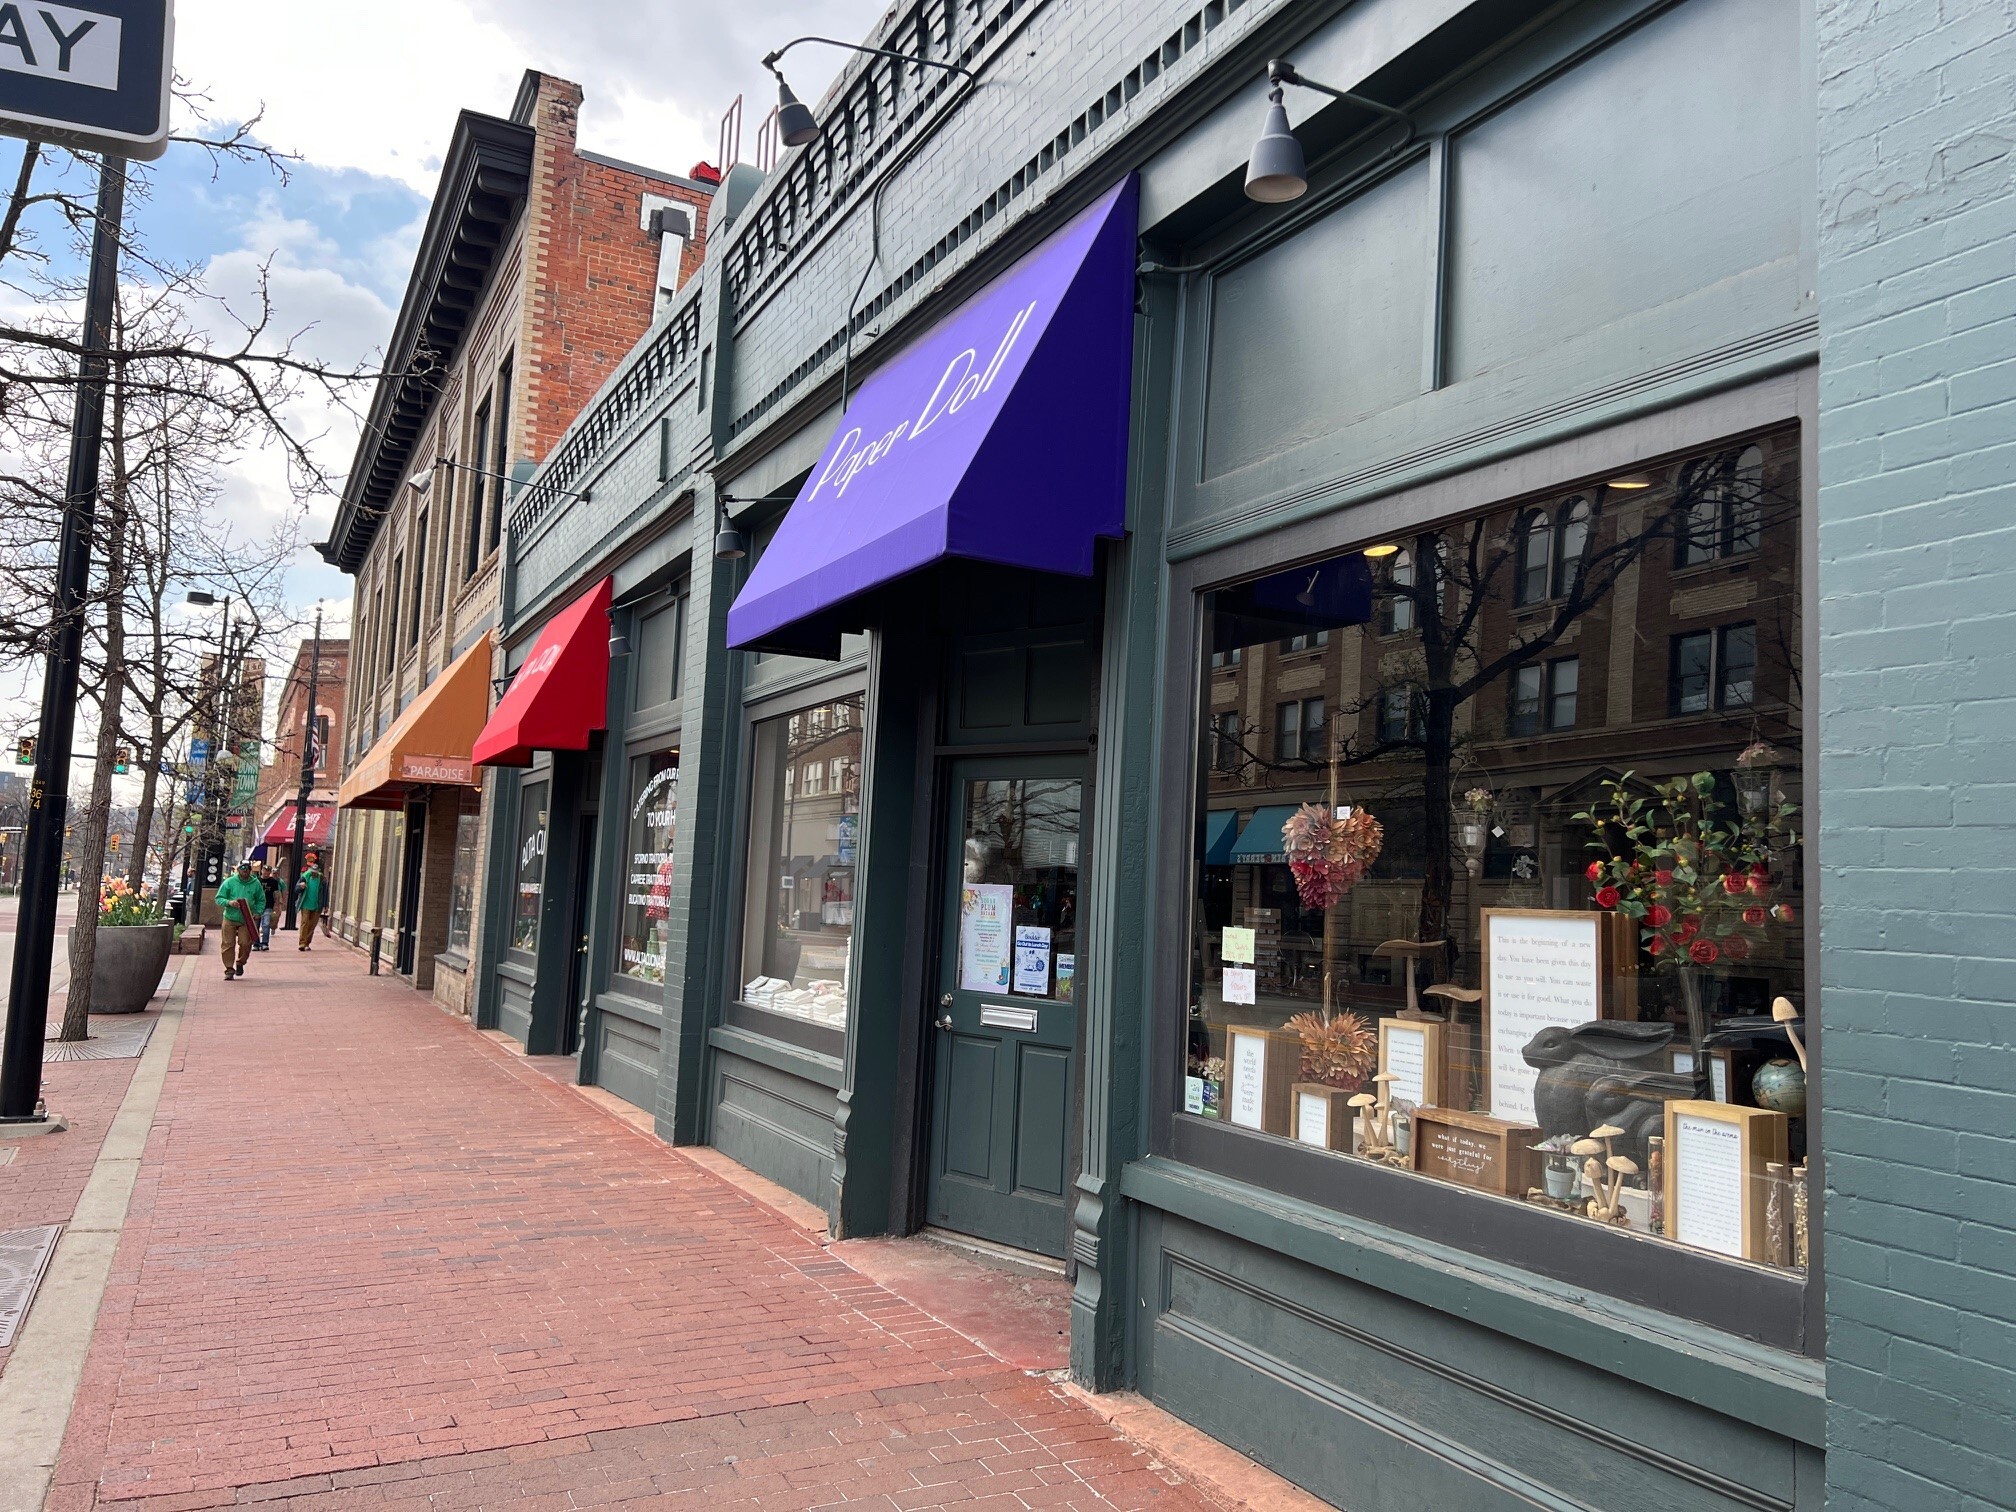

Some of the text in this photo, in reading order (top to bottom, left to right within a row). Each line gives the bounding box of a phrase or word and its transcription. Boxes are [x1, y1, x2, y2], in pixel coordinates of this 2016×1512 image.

[0, 3, 97, 72] AY
[808, 300, 1037, 502] Paper Doll
[410, 765, 464, 780] PARADISE
[653, 769, 667, 789] FROM
[667, 768, 676, 780] OUR
[236, 774, 257, 790] TOWN
[647, 811, 655, 827] TO
[655, 810, 671, 826] YOUR
[521, 834, 536, 871] ALTA
[1498, 936, 1509, 944] This
[1531, 938, 1559, 948] beginning
[1509, 954, 1519, 962] You
[1536, 956, 1549, 964] been
[1551, 959, 1566, 967] given
[1568, 959, 1579, 967] this
[1580, 960, 1591, 969] day
[1549, 976, 1560, 984] You
[1554, 995, 1569, 1004] What
[1498, 1010, 1512, 1018] today
[1520, 1013, 1545, 1021] important
[1547, 1014, 1568, 1022] because
[1498, 1028, 1527, 1038] exchanging
[1498, 1045, 1513, 1053] When
[1498, 1083, 1525, 1094] something
[1520, 1103, 1529, 1111] Let
[1437, 1133, 1450, 1142] what
[1431, 1142, 1444, 1150] were
[1459, 1149, 1480, 1158] grateful
[1483, 1153, 1492, 1161] for
